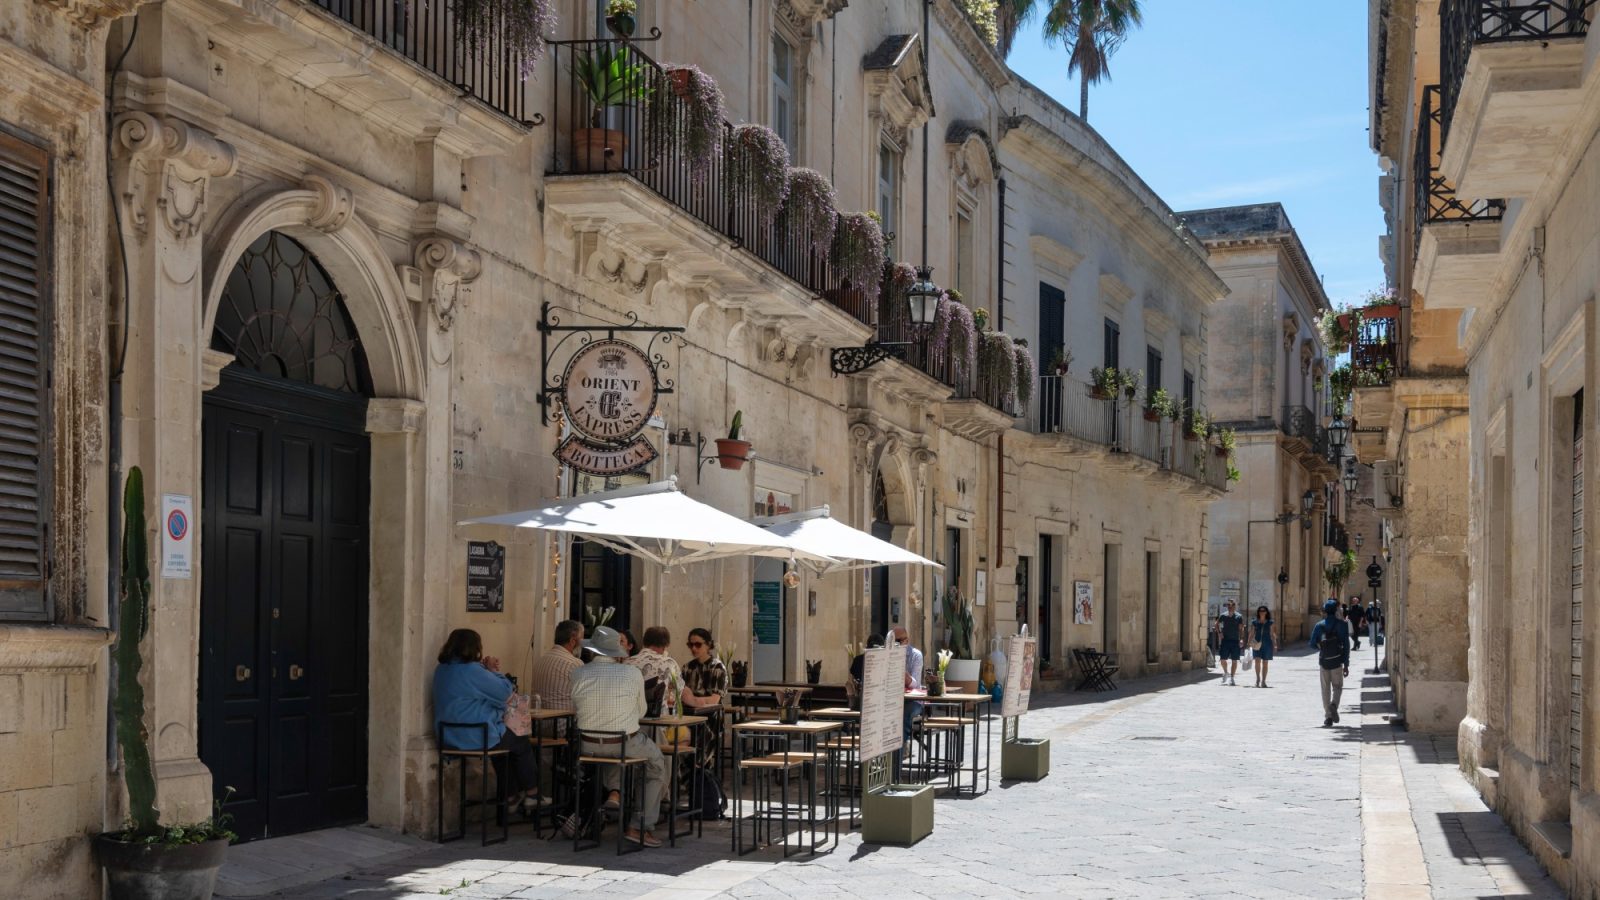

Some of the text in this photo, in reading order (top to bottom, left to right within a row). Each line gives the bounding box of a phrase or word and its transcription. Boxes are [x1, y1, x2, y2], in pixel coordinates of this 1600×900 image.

[581, 377, 641, 391] ORIENT
[574, 406, 642, 435] EXPRESS
[570, 448, 644, 469] BOTTEGA
